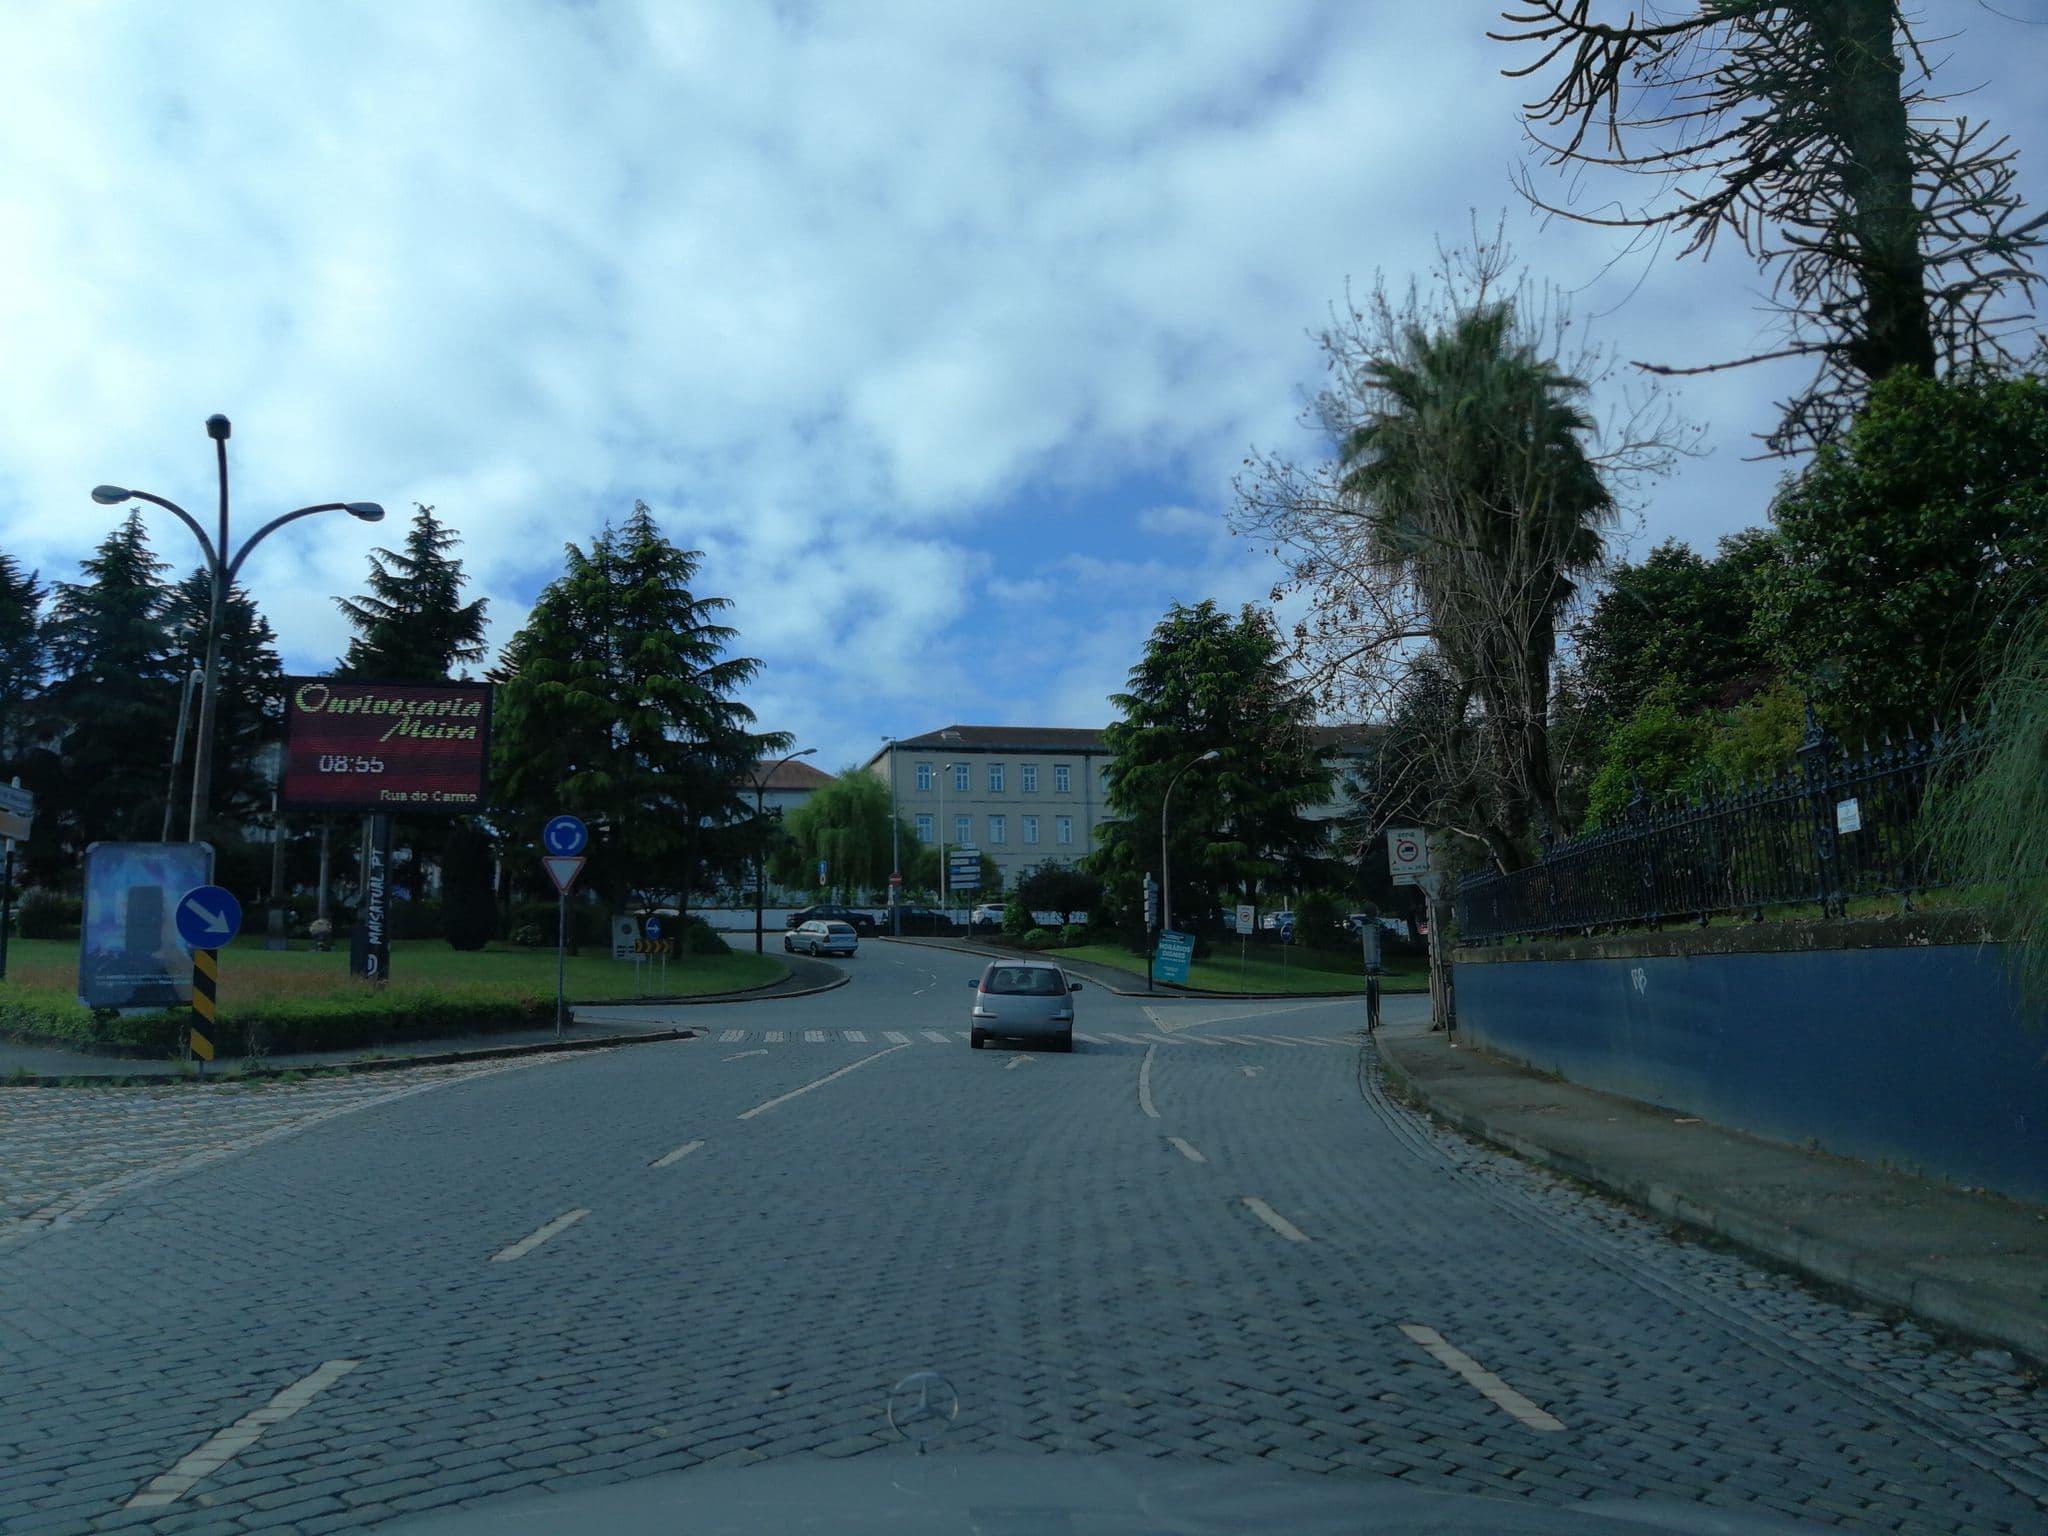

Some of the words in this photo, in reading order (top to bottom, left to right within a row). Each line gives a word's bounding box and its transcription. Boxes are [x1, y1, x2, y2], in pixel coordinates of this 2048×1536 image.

[379, 715, 478, 742] Meira
[319, 755, 385, 774] 08:55
[380, 789, 408, 802] Rua
[410, 790, 429, 802] do
[431, 790, 478, 803] Carmo
